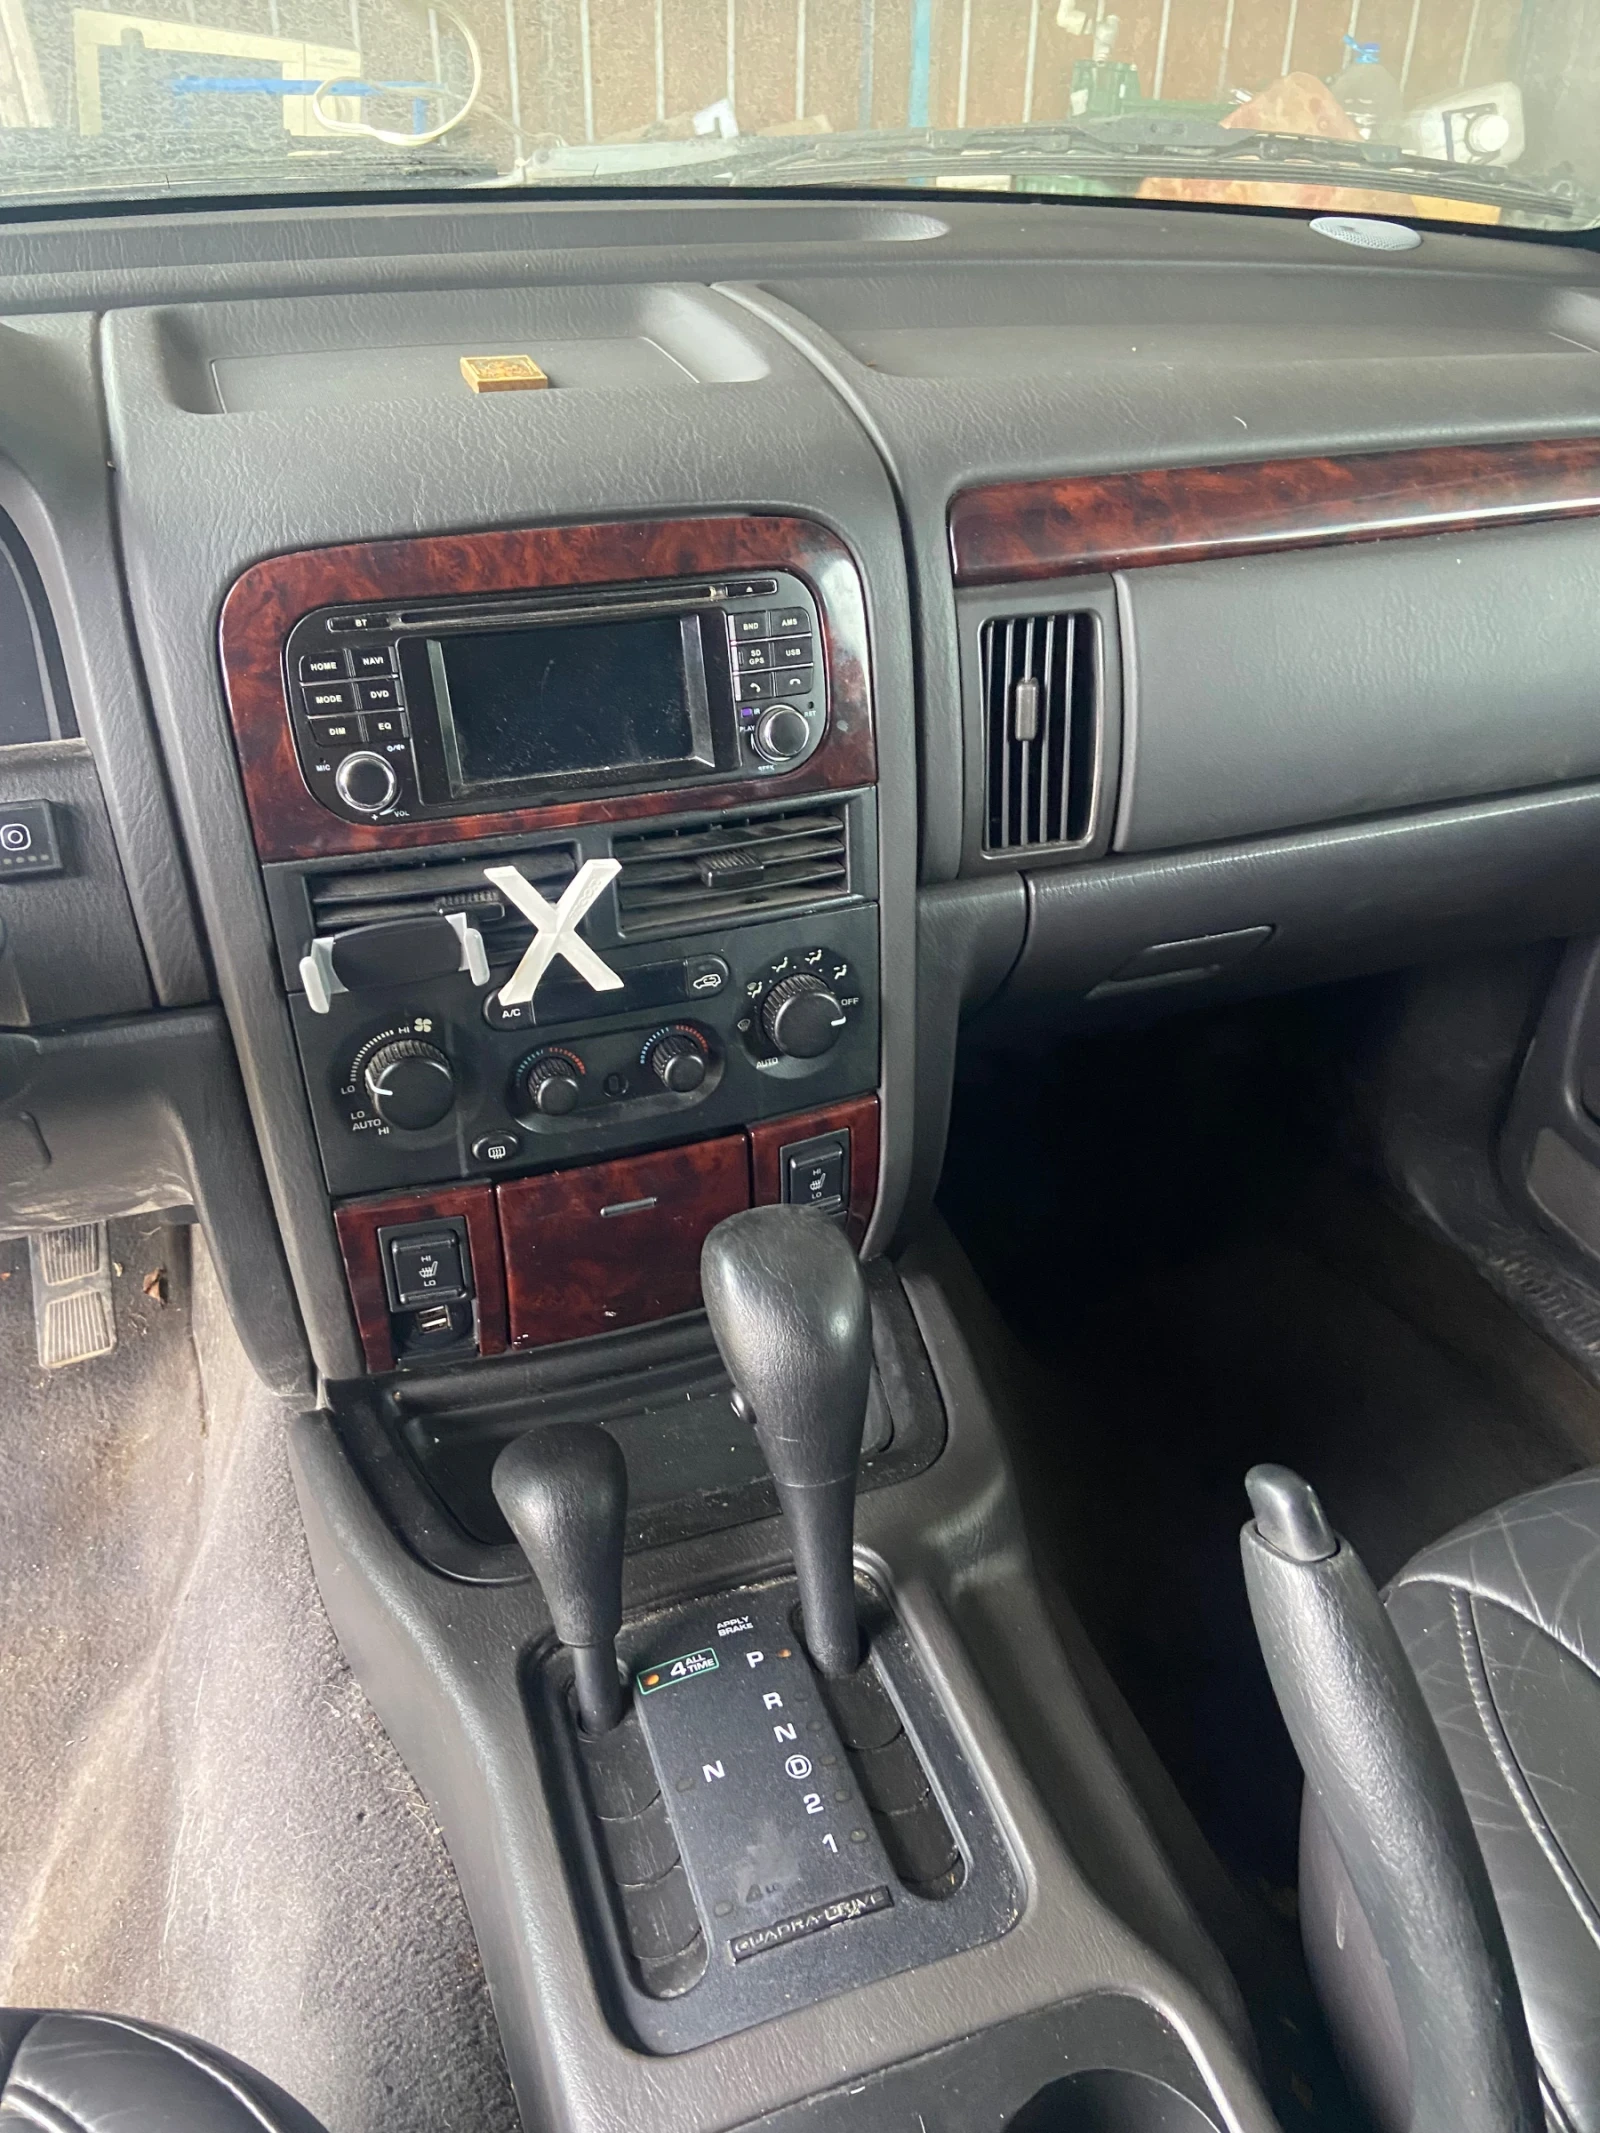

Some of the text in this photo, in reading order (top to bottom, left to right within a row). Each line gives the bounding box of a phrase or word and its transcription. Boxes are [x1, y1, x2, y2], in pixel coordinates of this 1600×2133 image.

[355, 619, 367, 627] BT
[743, 622, 759, 631] BND
[781, 618, 798, 627] AMS
[750, 649, 761, 657] SD
[785, 648, 801, 656] USB
[362, 656, 384, 665] NAVI
[749, 657, 765, 665] GPS
[310, 661, 337, 671] HOME
[370, 690, 389, 699] DVD
[315, 695, 342, 704] MODE
[378, 722, 392, 730] EQ
[739, 725, 755, 733] PLAY
[328, 727, 346, 736] DIM
[315, 764, 331, 772] MIC
[393, 810, 410, 818] VOL
[841, 997, 859, 1006] OFF
[502, 1008, 521, 1019] A/C
[398, 1026, 410, 1034] HI
[756, 1057, 779, 1070] AUTO
[340, 1085, 356, 1095] LO
[350, 1110, 365, 1120] LO
[352, 1118, 382, 1131] AUTO
[378, 1126, 390, 1136] HI
[812, 1168, 821, 1176] HI
[811, 1191, 822, 1200] LO
[716, 1616, 748, 1630] APPLY
[718, 1623, 754, 1637] BRAKE
[685, 1654, 706, 1666] ALL
[746, 1651, 764, 1668] P
[670, 1661, 687, 1678] 4
[687, 1658, 715, 1673] TIME
[762, 1692, 783, 1710] R
[773, 1723, 797, 1743] N
[702, 1760, 725, 1783] N
[803, 1793, 824, 1815] 2
[822, 1833, 838, 1853] 1
